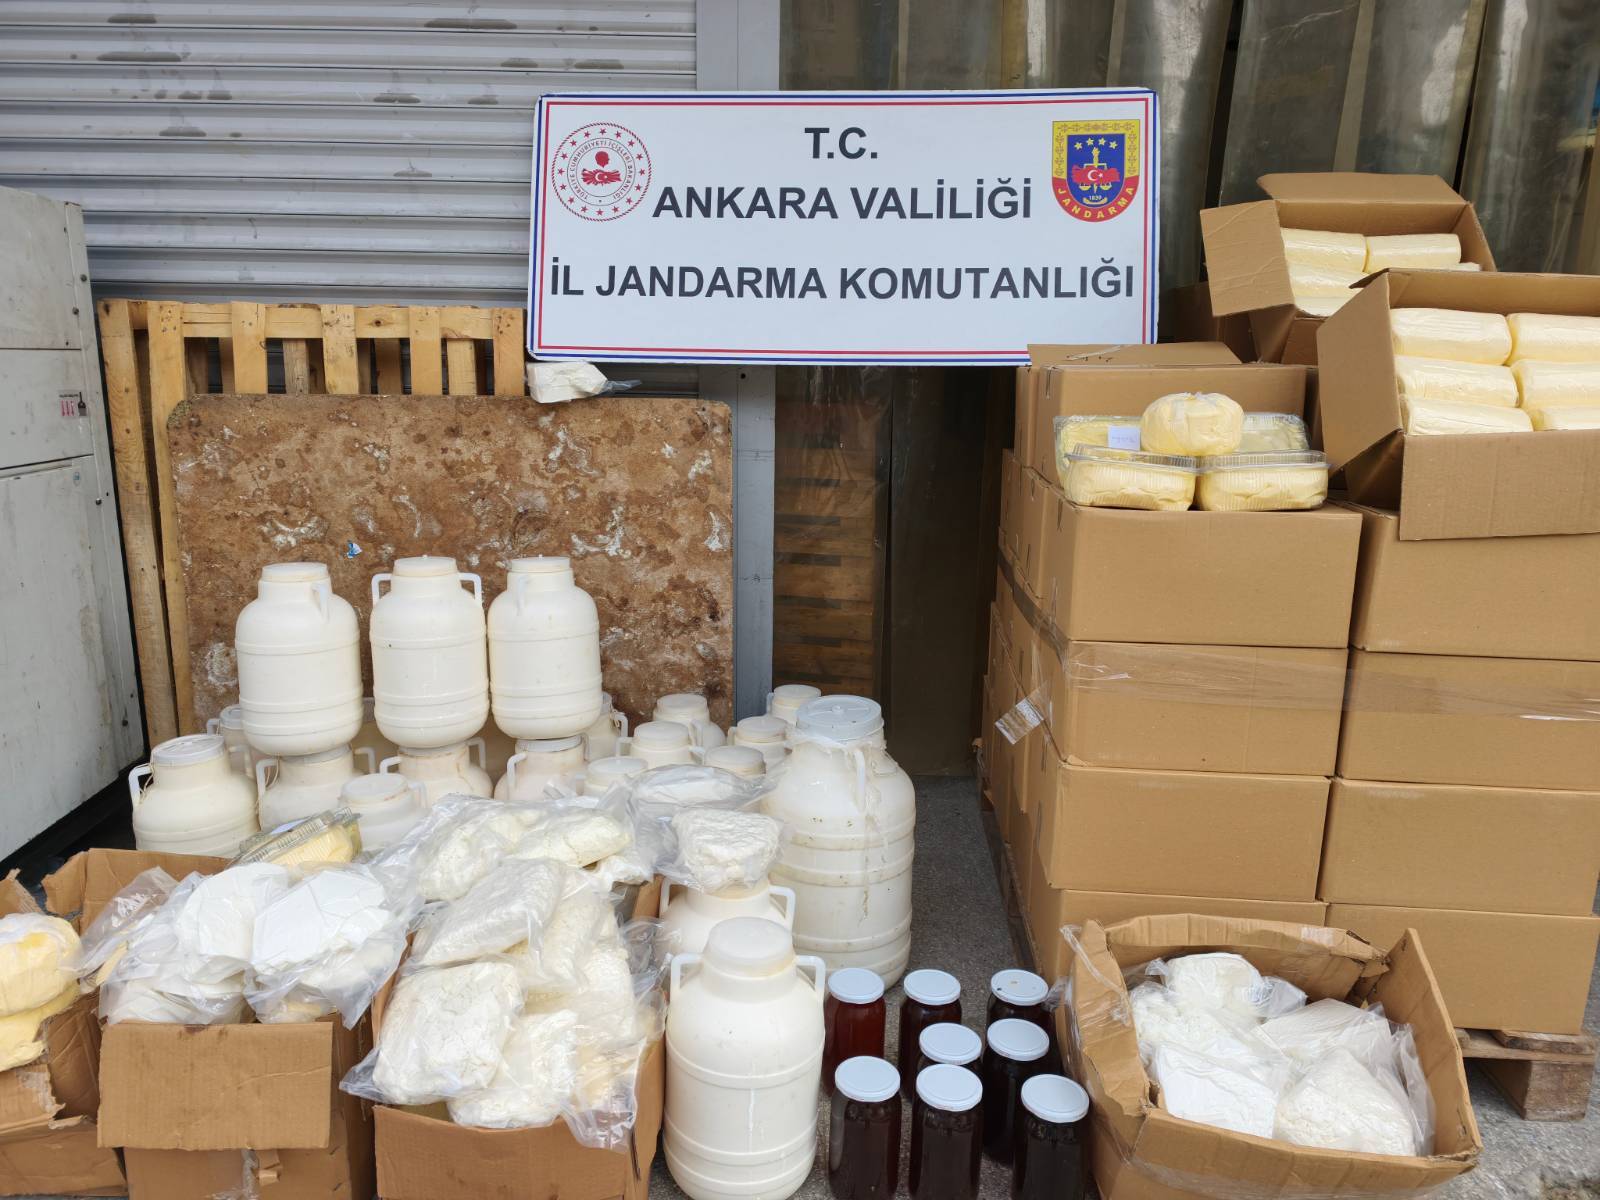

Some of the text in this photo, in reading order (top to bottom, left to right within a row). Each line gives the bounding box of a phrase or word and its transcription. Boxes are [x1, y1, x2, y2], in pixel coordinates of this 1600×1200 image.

[804, 127, 878, 160] T.C.
[569, 140, 633, 200] TÜRKİYE CUMHURİYETİ İÇİŞLERİ BAKANLIĞI
[652, 178, 1032, 220] ANKARA VALİLİĞİ
[1057, 187, 1134, 218] JANDARMA
[551, 256, 1135, 300] İL JANDARMA KOMUTANLIĞI
